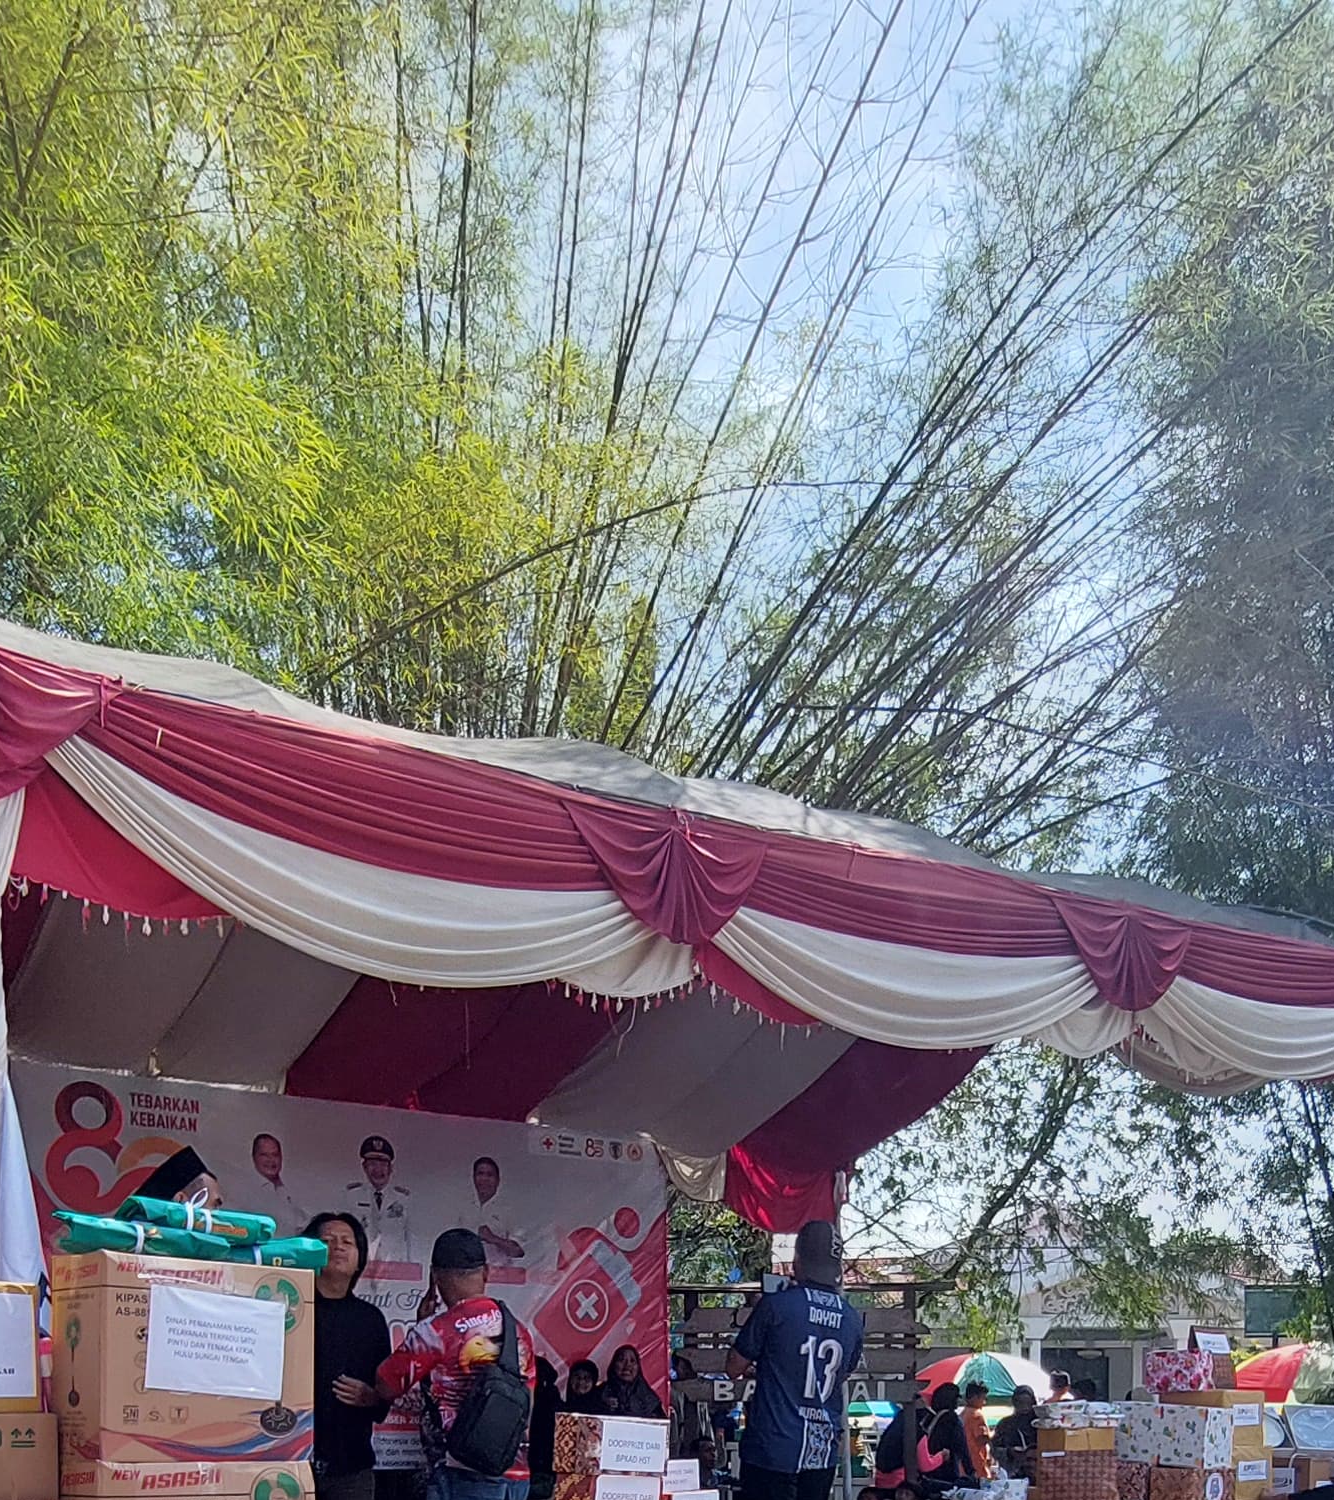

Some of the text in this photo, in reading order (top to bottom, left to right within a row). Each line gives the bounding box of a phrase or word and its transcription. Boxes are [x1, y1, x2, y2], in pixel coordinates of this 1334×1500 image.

[130, 1092, 200, 1114] TEBARKAN
[130, 1111, 198, 1132] KEBAIKAN
[117, 1261, 145, 1274] NEW
[116, 1292, 148, 1304] KIPAS
[809, 1306, 843, 1329] DAYAT
[189, 1341, 205, 1350] DAN
[799, 1335, 844, 1404] 13
[608, 1439, 661, 1449] DOORPRIZE DARI
[616, 1454, 651, 1465] BPKAD HST
[111, 1468, 222, 1490] NEW ASASHI
